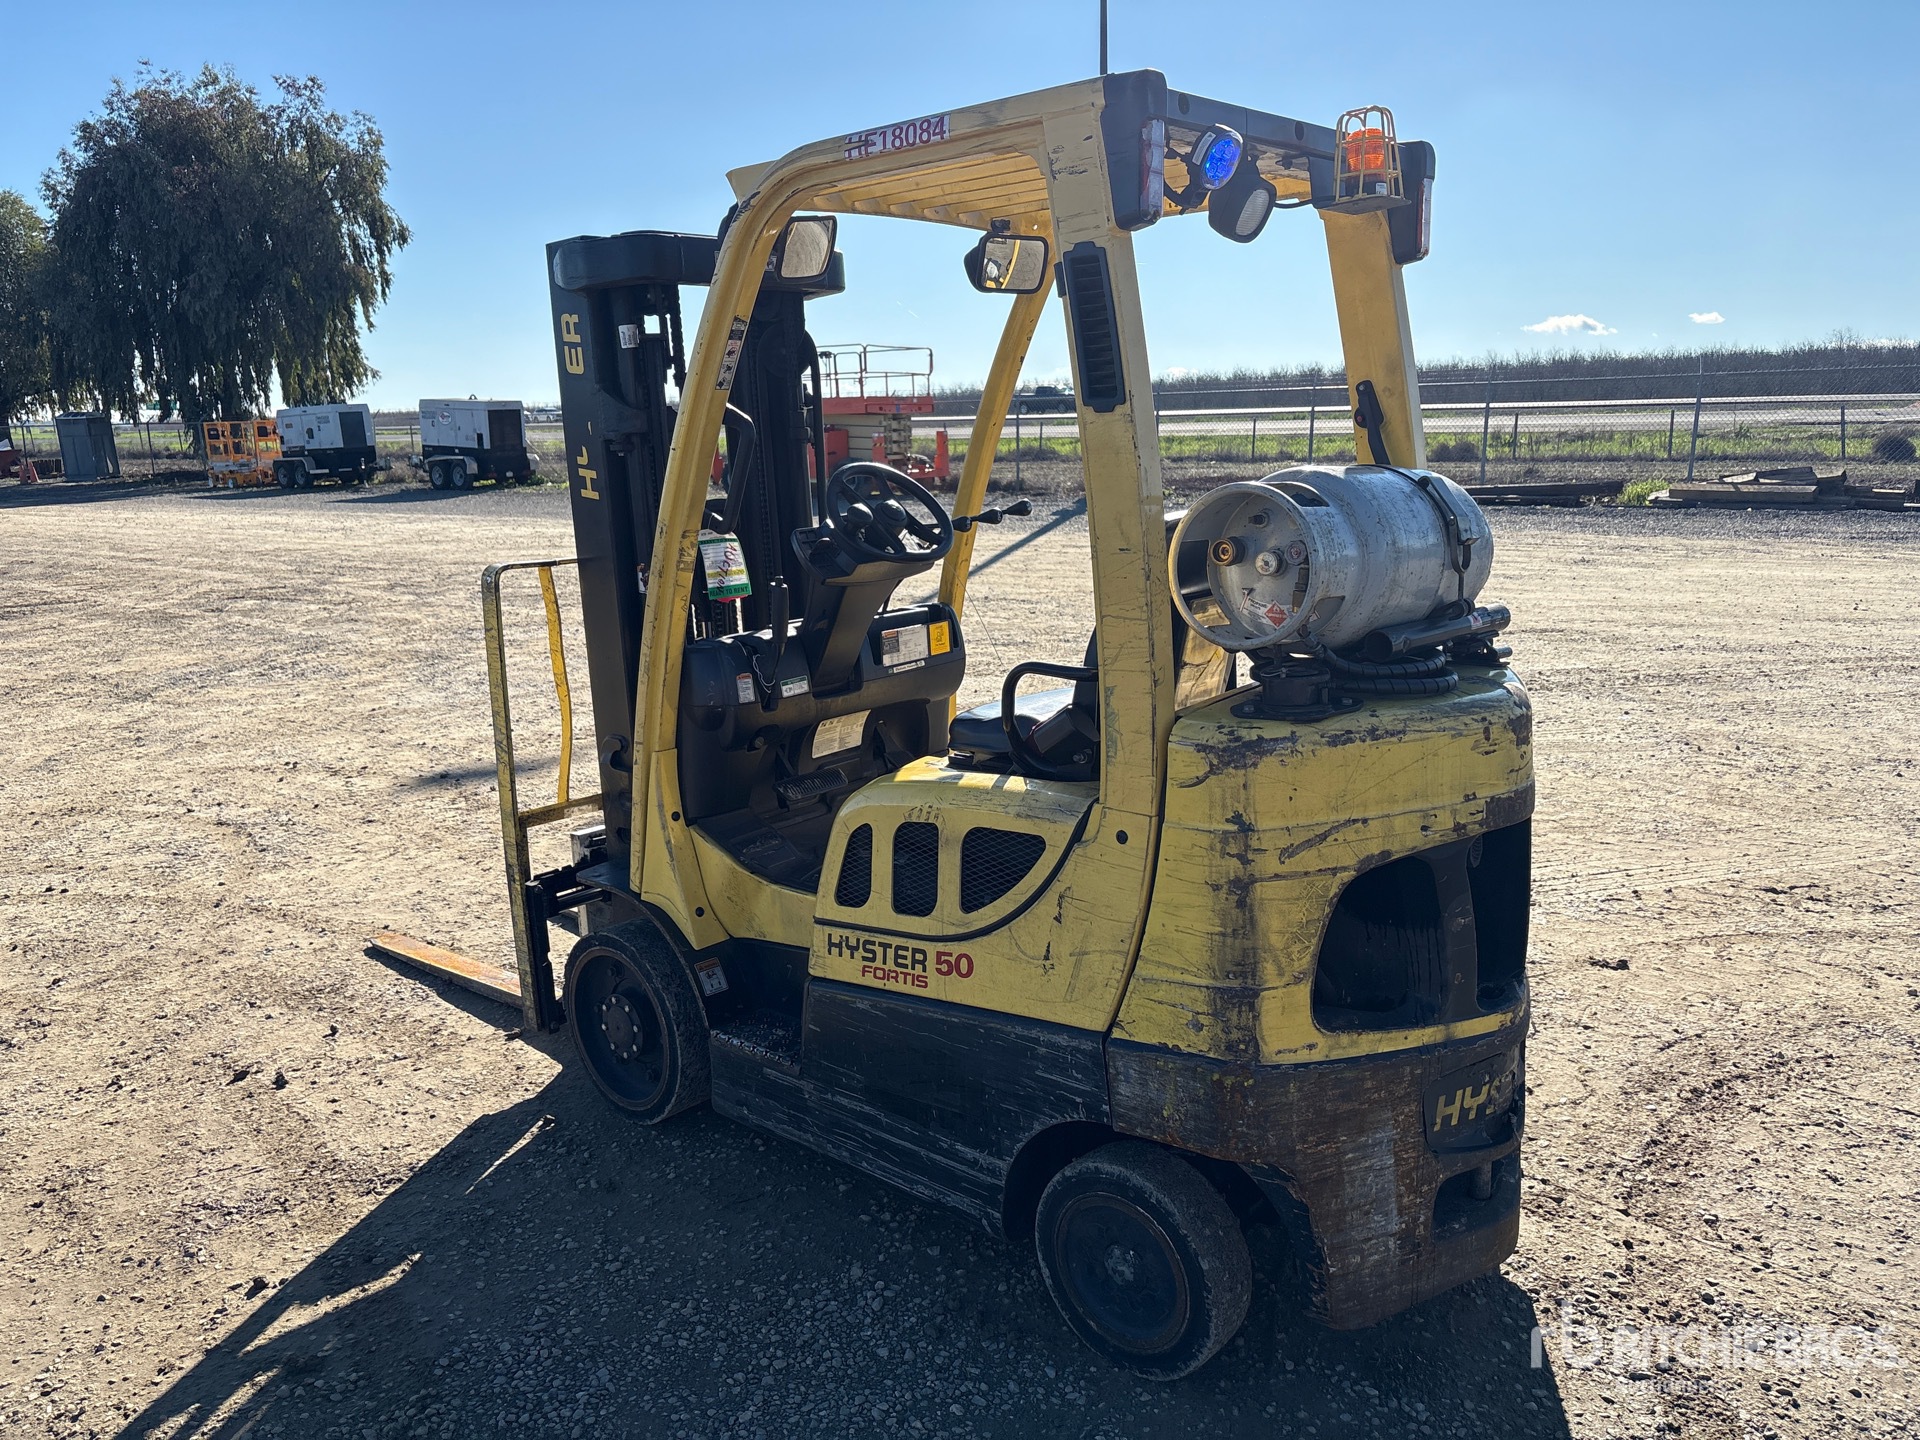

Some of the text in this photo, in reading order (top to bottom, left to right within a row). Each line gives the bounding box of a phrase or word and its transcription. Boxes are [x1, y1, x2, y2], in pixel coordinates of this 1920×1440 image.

[827, 933, 975, 979] HYSTER 50
[861, 964, 929, 989] FORTIS
